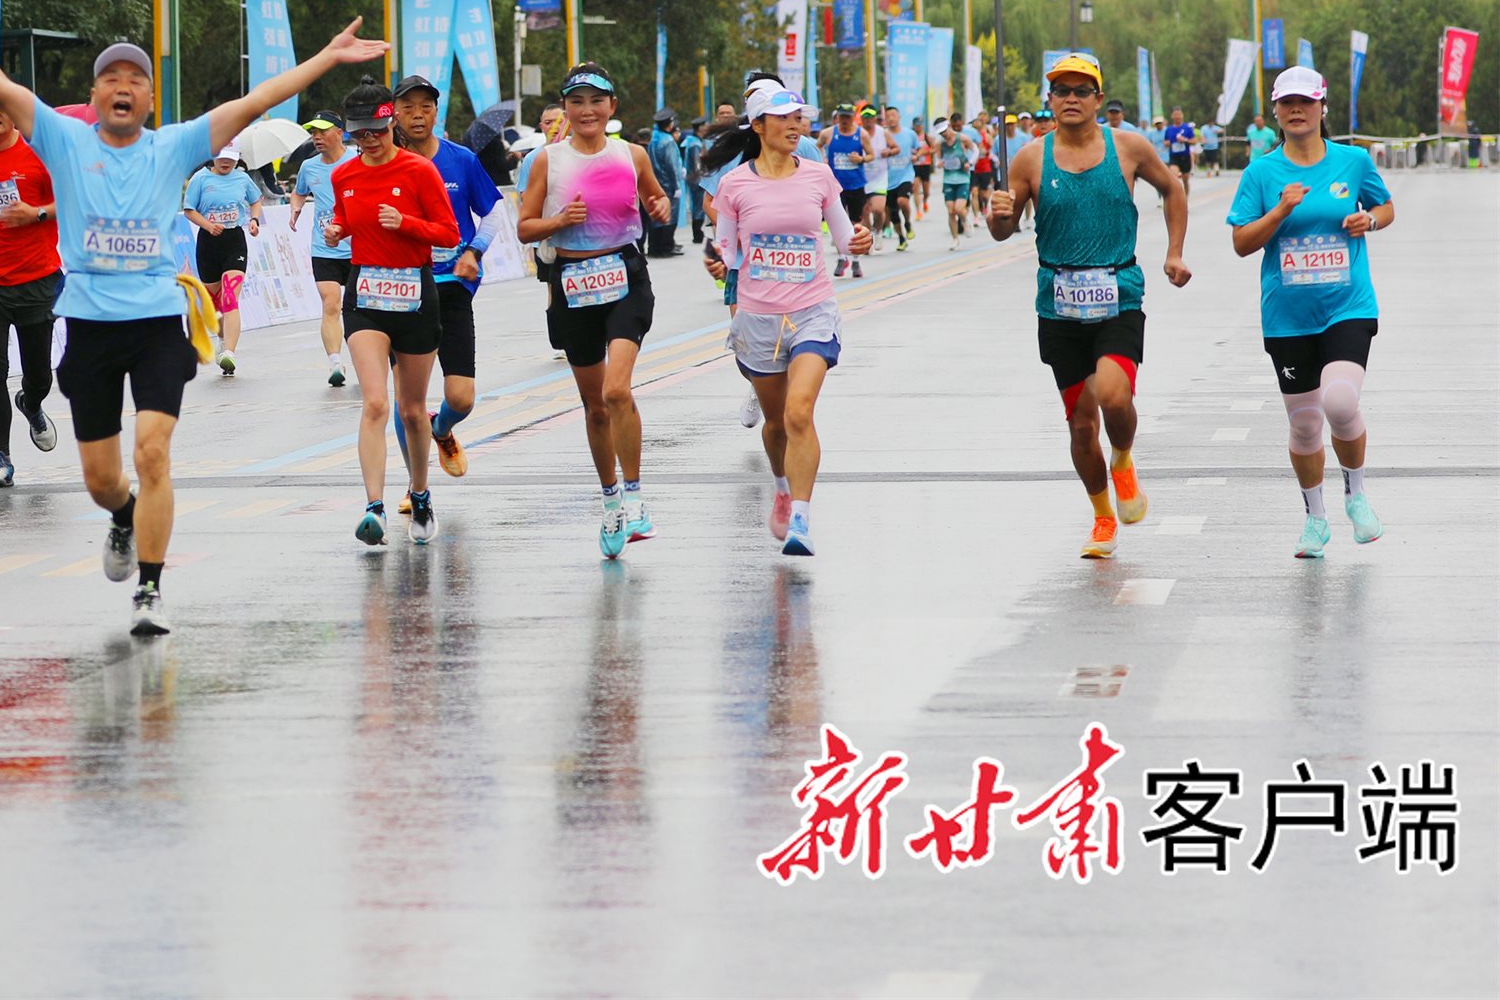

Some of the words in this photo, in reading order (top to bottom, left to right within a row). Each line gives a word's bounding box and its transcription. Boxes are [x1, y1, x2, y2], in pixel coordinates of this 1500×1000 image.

[209, 213, 216, 221] A
[219, 211, 238, 221] 1212
[86, 232, 100, 249] A
[105, 237, 157, 253] 10657
[752, 247, 764, 262] A
[768, 251, 812, 267] 12018
[1283, 253, 1296, 267] A
[1302, 251, 1344, 267] 12119
[358, 278, 370, 292] A
[376, 281, 416, 297] 12101
[566, 278, 578, 292] A
[580, 270, 625, 290] 12034
[1055, 285, 1066, 300] A
[1069, 288, 1115, 303] 10186
